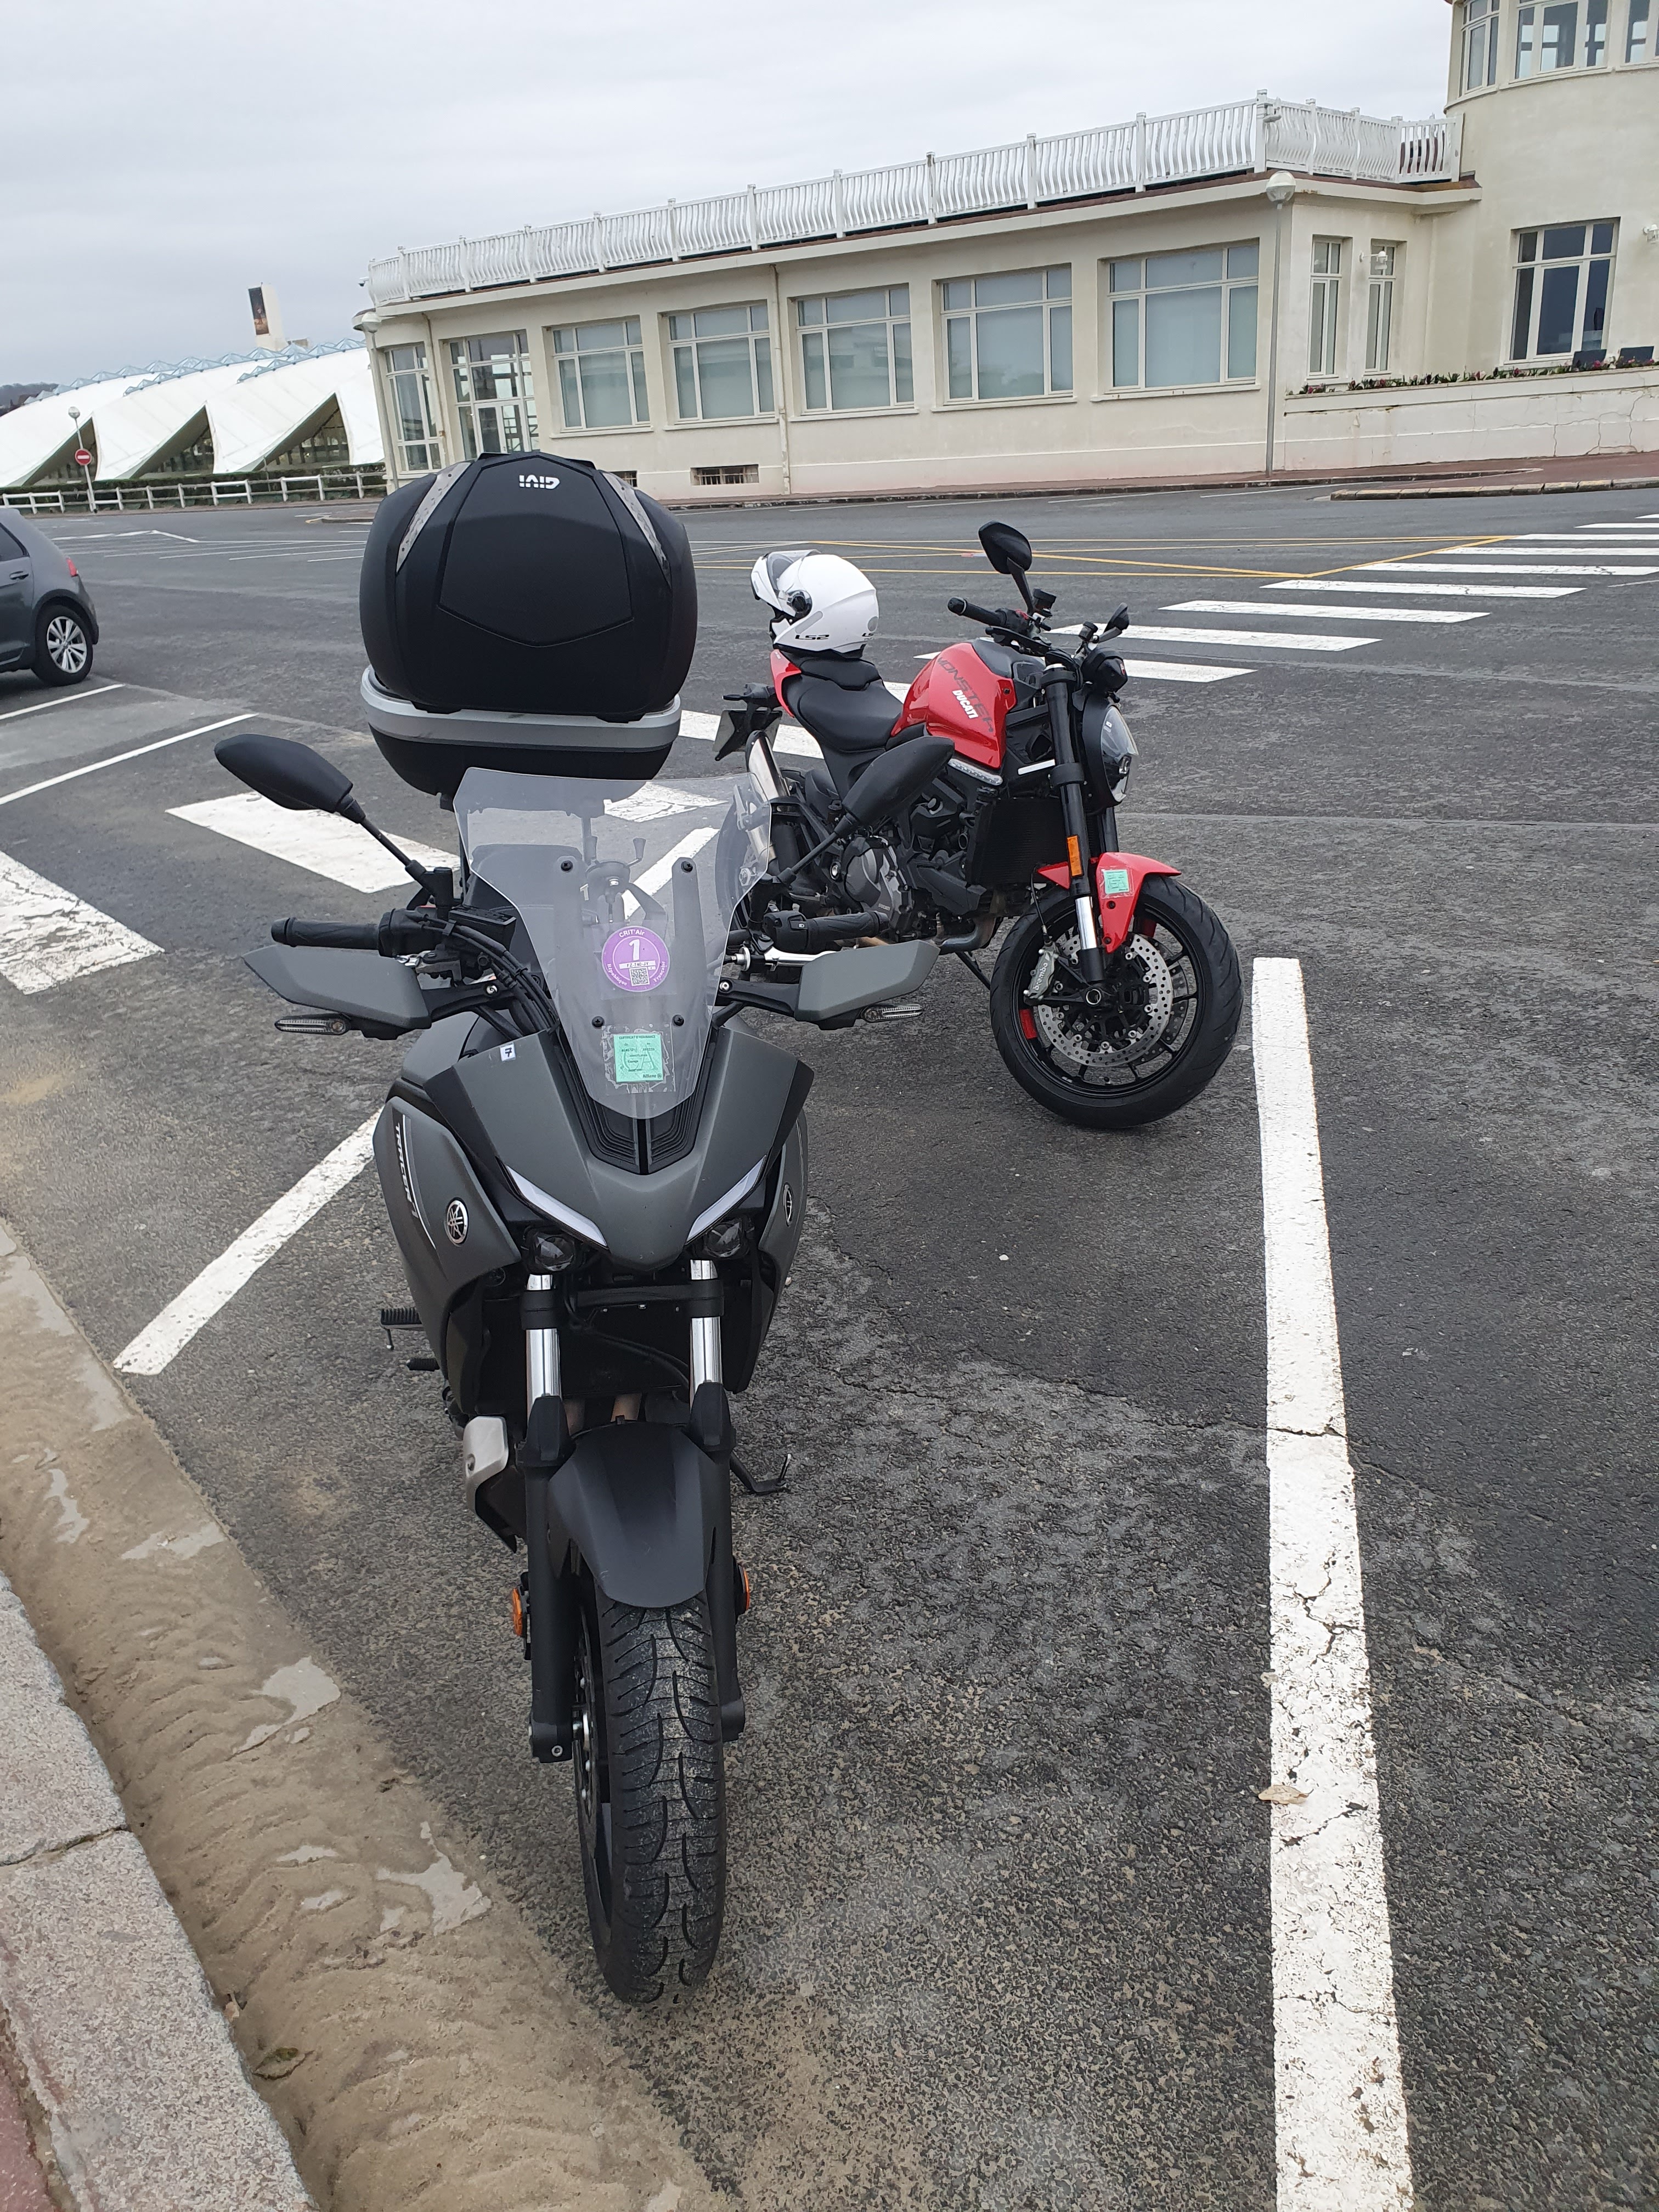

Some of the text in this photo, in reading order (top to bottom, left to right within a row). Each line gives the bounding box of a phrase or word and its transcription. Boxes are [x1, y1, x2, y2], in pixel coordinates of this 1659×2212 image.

[952, 690, 978, 719] DUCATI
[629, 939, 640, 961] 1
[1032, 962, 1048, 991] brembo
[395, 1122, 413, 1202] TRACER
